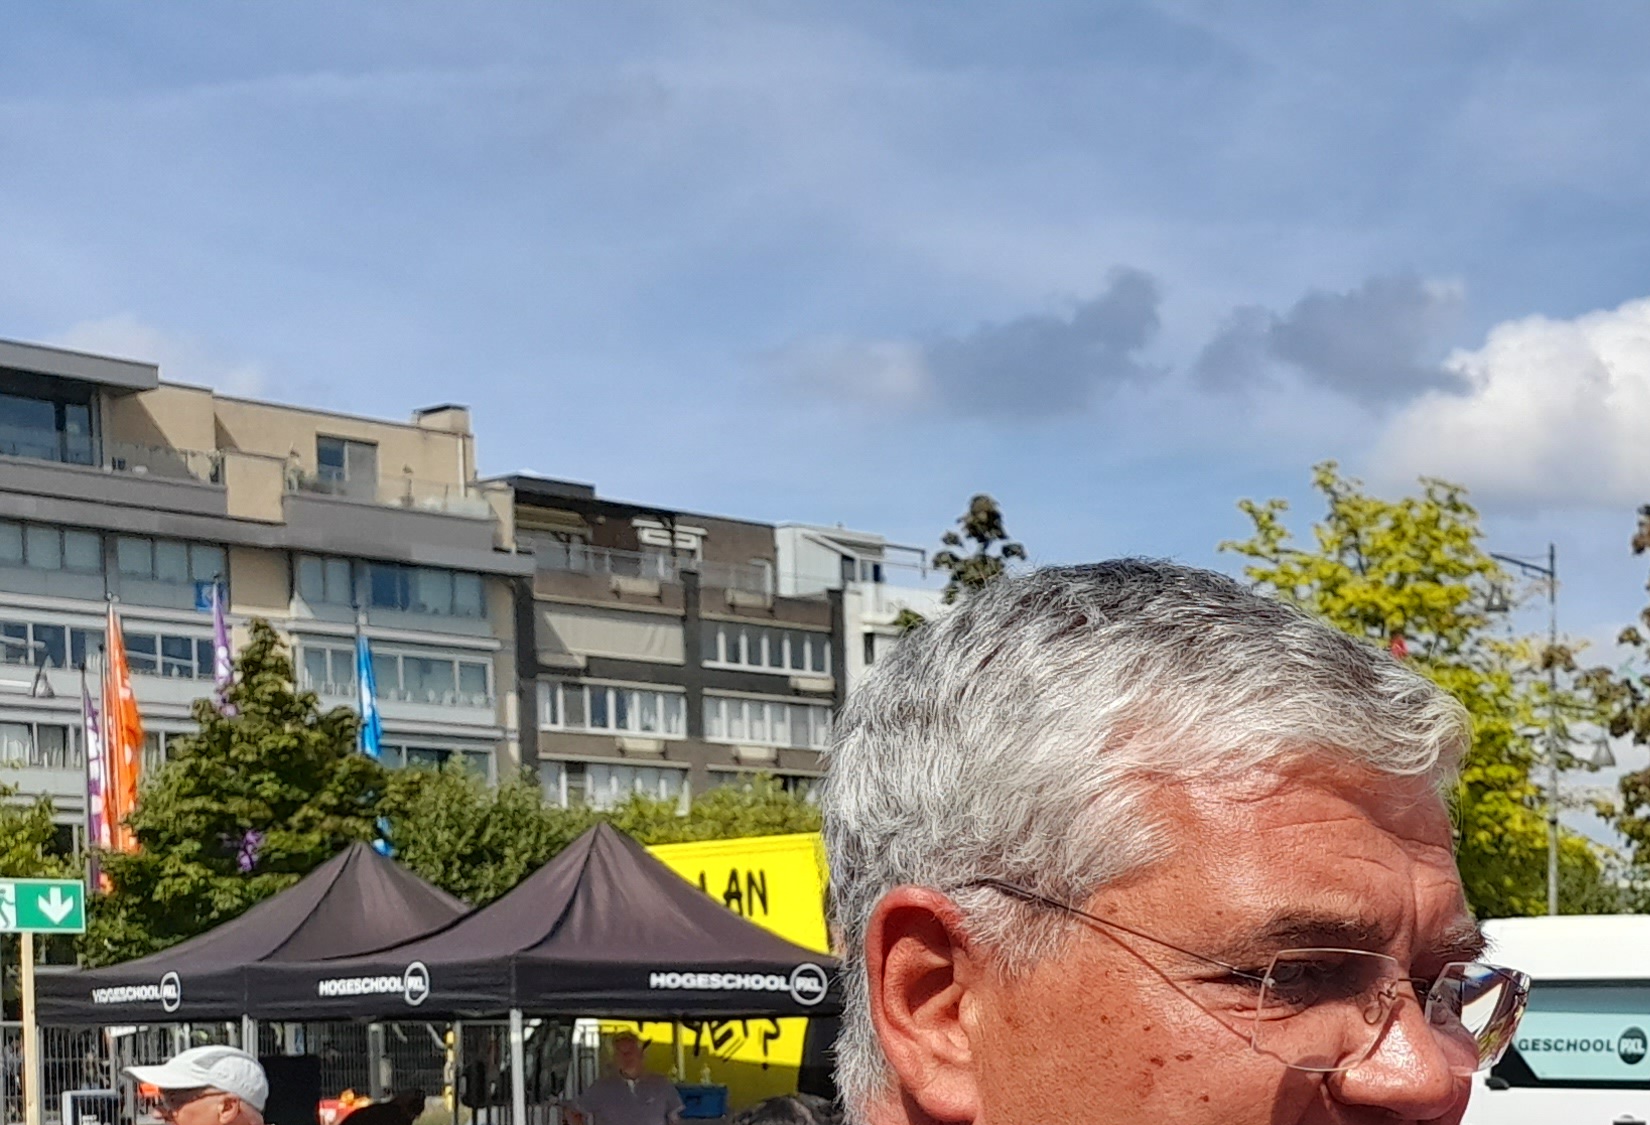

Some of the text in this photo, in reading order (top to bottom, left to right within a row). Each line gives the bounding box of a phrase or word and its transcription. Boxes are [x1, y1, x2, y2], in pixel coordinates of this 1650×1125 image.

[319, 976, 405, 996] HOGESCHOOL
[650, 973, 791, 991] HOGESCHOOL
[1518, 1038, 1615, 1053] GESCHOOL
